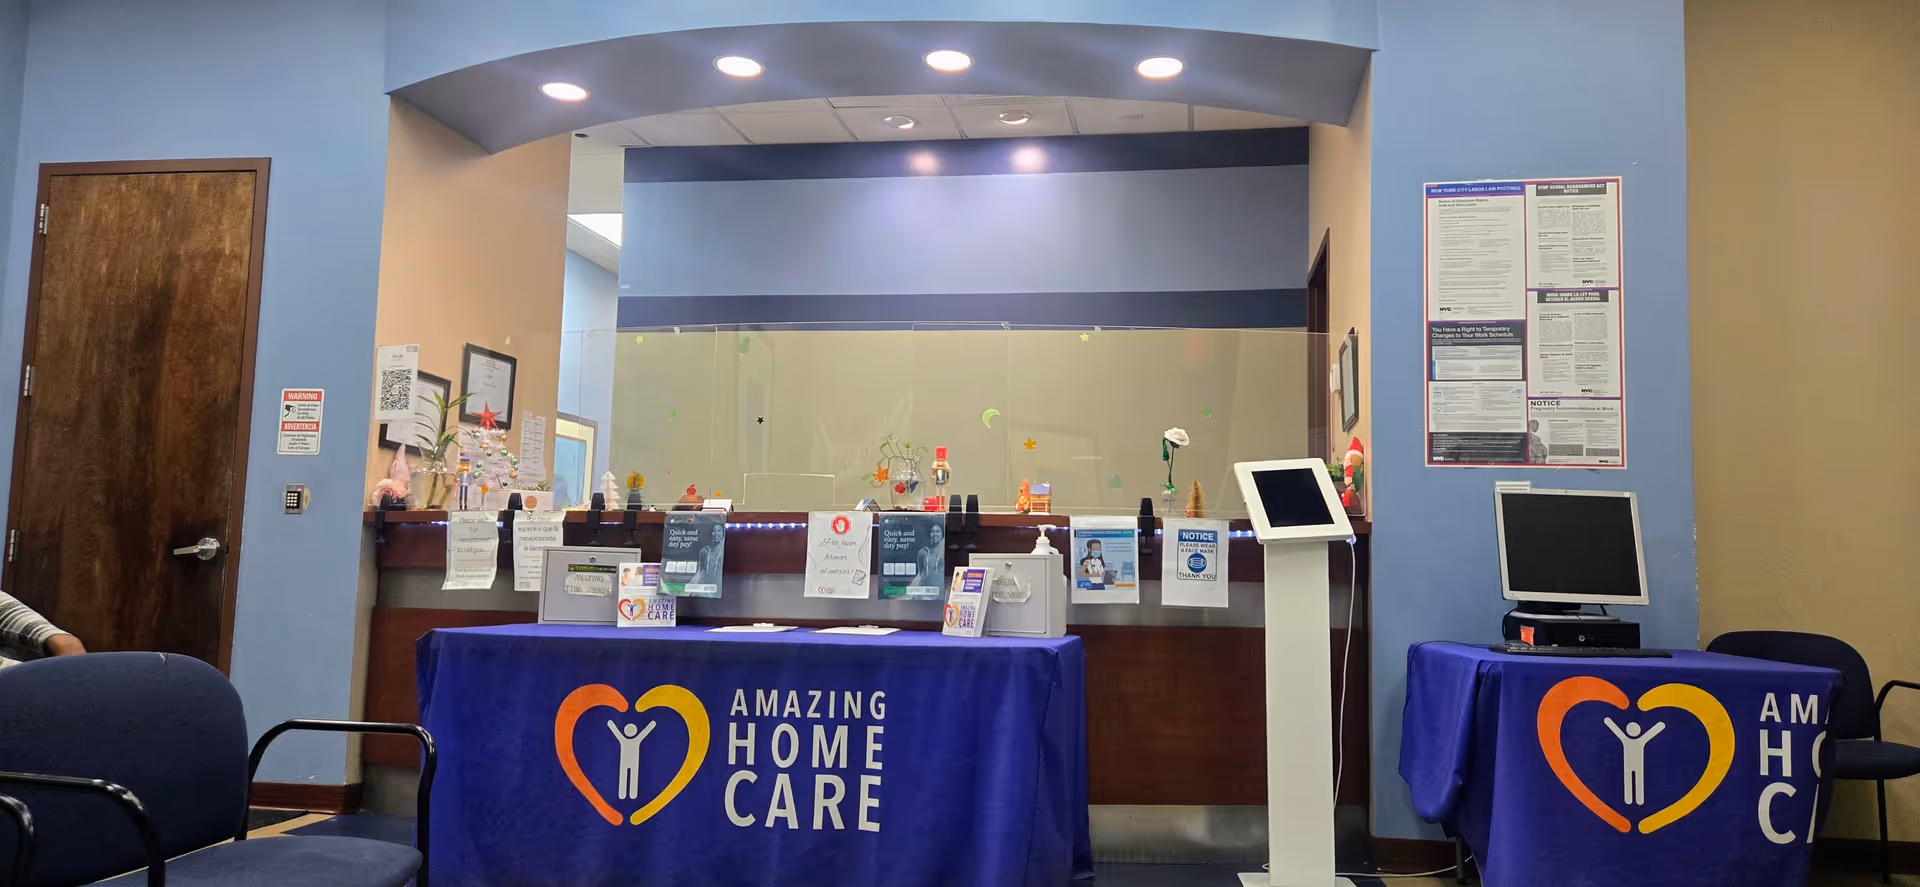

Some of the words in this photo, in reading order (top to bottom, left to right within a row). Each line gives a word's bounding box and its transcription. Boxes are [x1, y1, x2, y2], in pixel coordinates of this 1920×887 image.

[1182, 532, 1214, 540] NOTICE
[822, 553, 848, 561] firmar
[574, 573, 604, 582] AMAZING
[647, 611, 675, 620] CARE
[959, 609, 975, 618] HOME
[958, 617, 974, 628] CARE
[730, 688, 886, 720] AMAZING
[1760, 692, 1829, 724] AM
[728, 722, 884, 770] HOME
[724, 769, 882, 832] CARE
